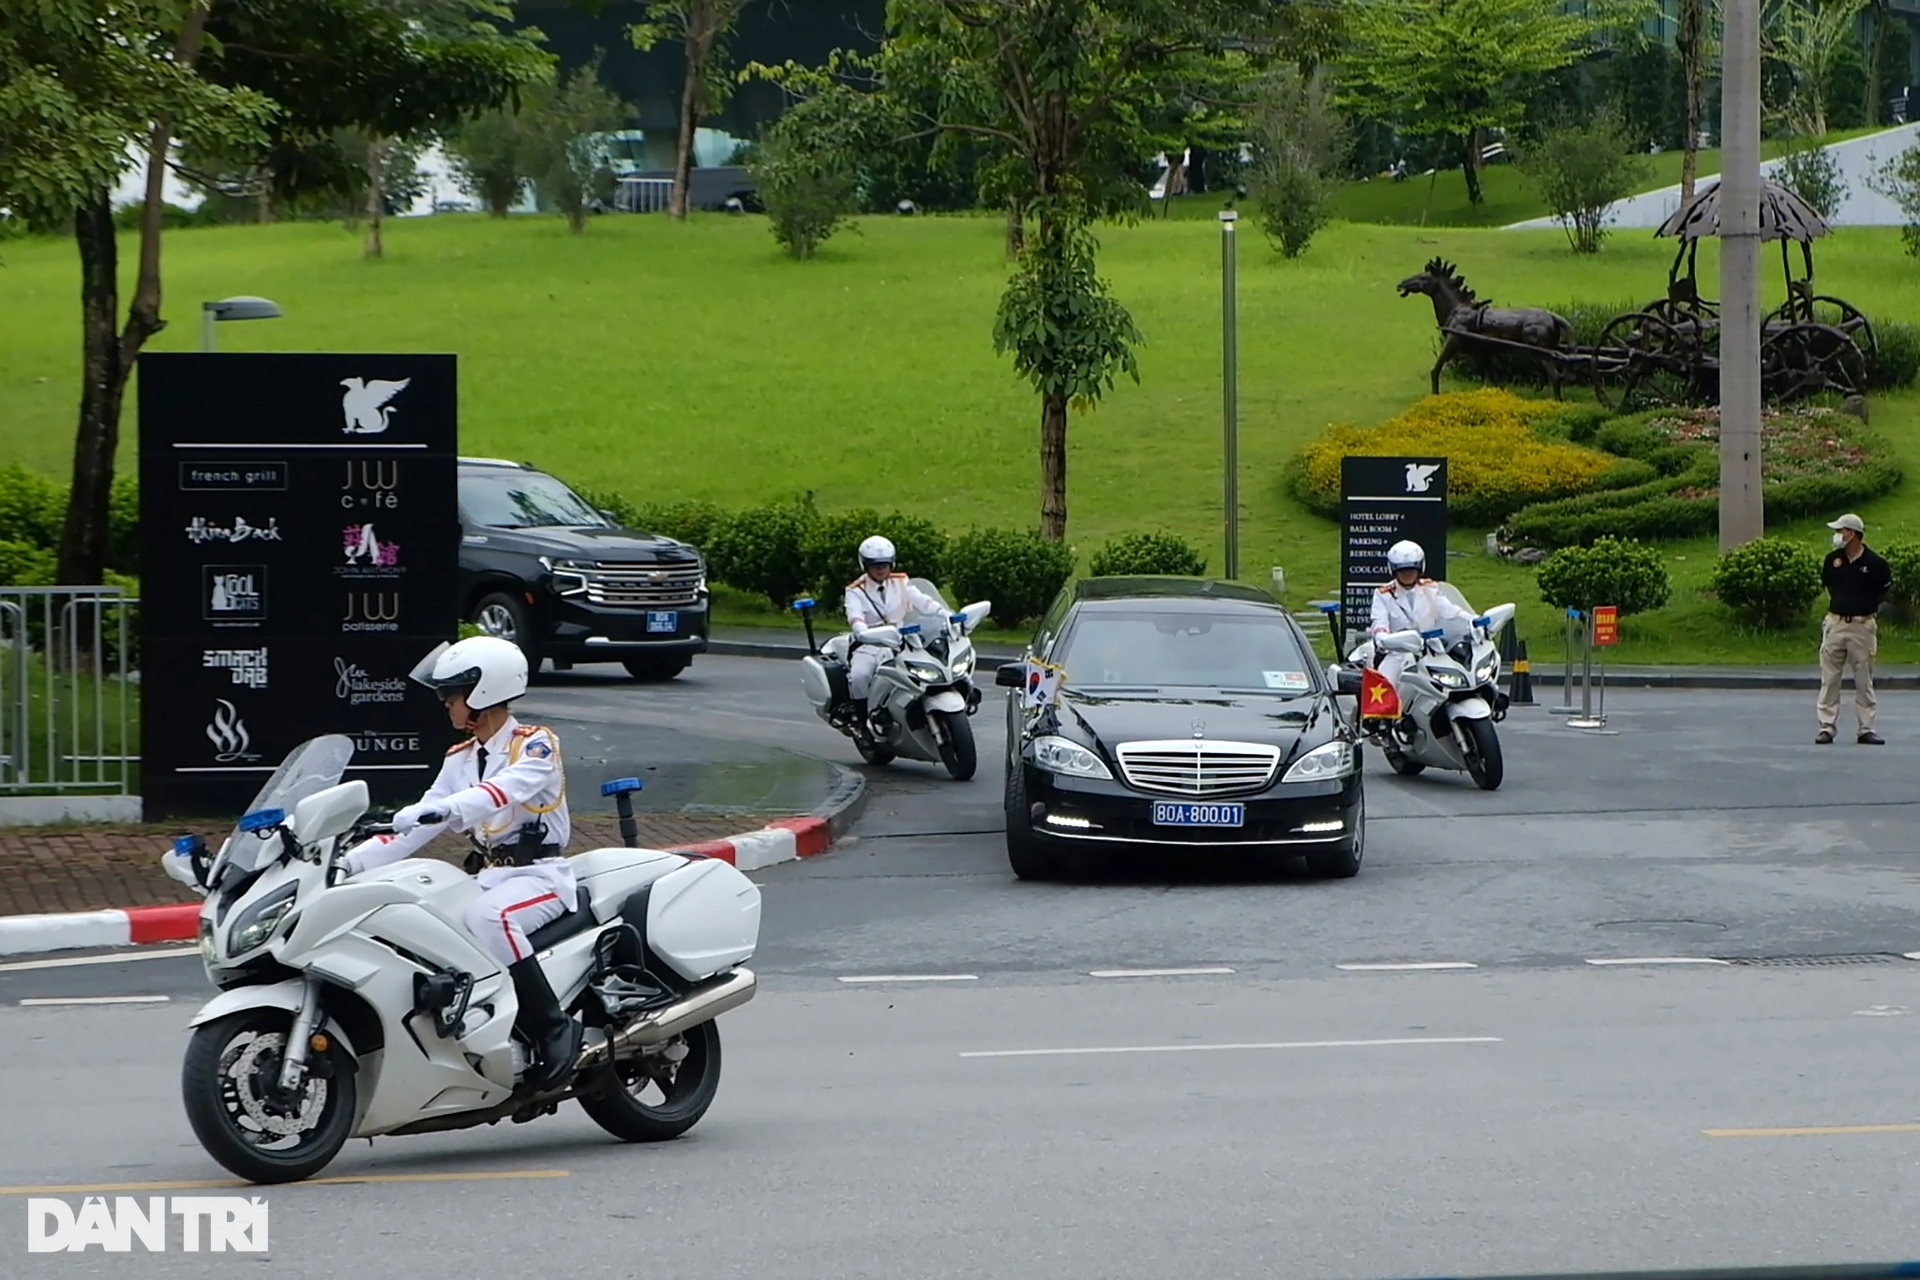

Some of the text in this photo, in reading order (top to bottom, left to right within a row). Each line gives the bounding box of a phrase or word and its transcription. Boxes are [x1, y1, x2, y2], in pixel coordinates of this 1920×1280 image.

[191, 470, 277, 483] french grill
[342, 460, 397, 490] JW
[1349, 566, 1371, 574] COOL
[342, 592, 399, 620] JW
[342, 622, 399, 631] patisserie
[351, 678, 407, 691] lakeside
[350, 691, 405, 705] gardens
[356, 738, 420, 752] UNGE
[1156, 805, 1238, 824] 80A-800.01
